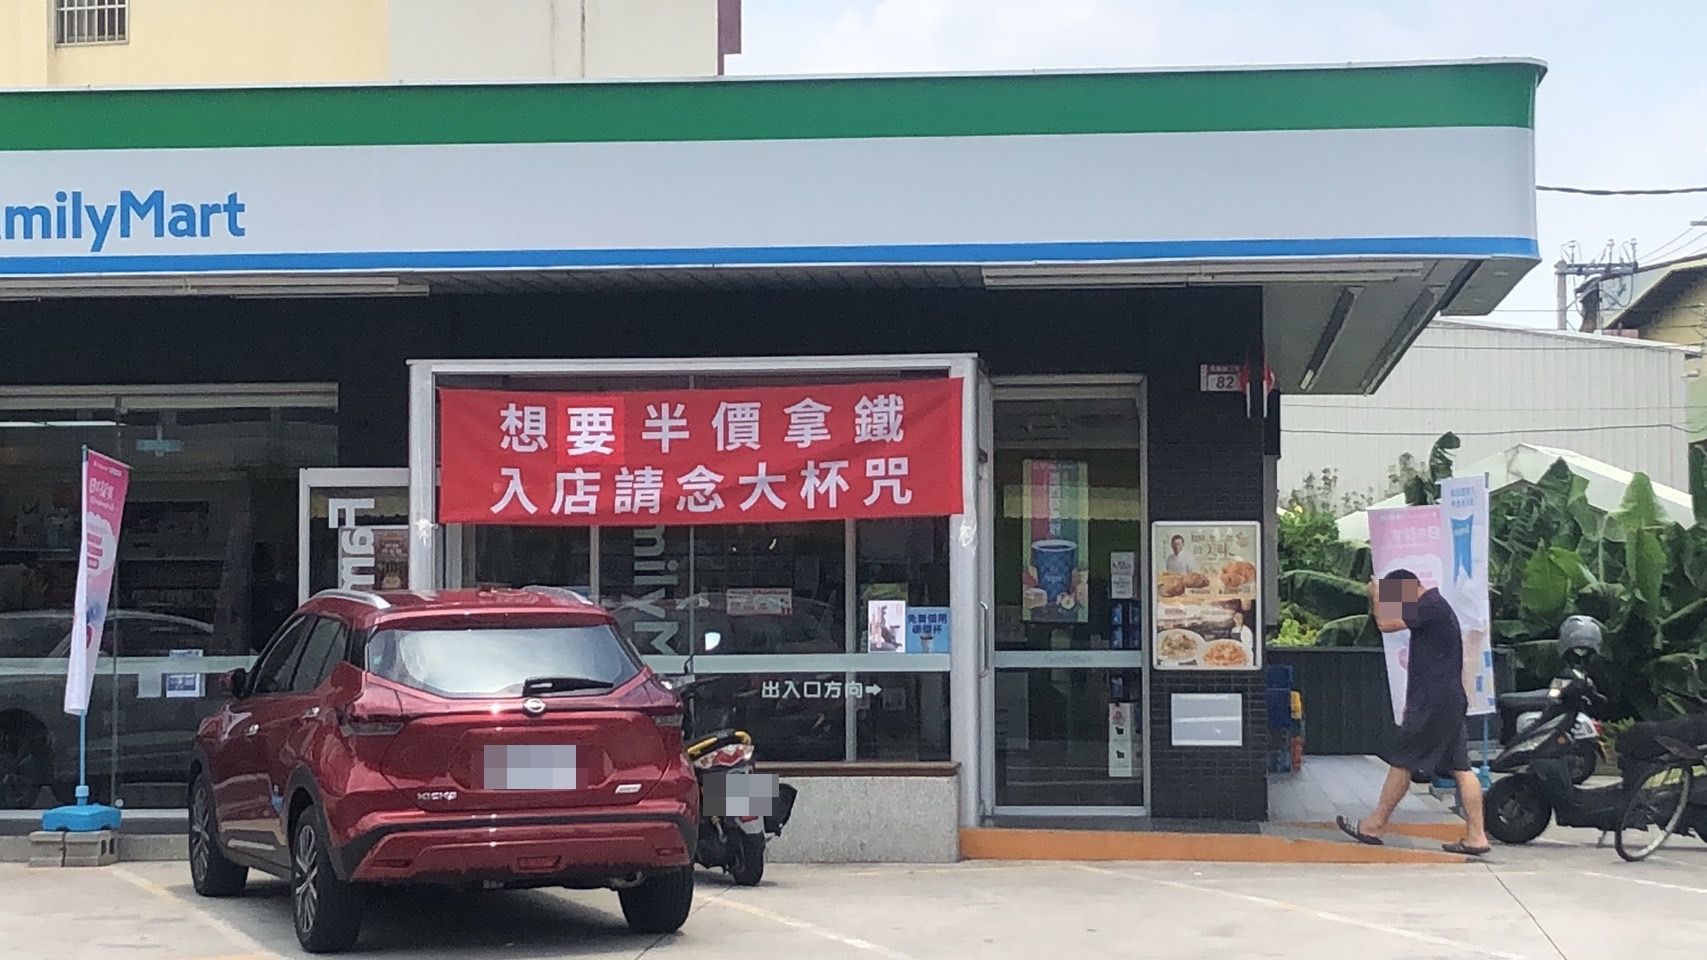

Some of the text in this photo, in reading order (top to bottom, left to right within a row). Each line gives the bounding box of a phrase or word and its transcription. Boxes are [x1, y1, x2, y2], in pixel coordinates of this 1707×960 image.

[0, 190, 245, 252] milyMart
[1216, 376, 1234, 389] 82
[500, 394, 904, 456] 想要半價拿鐵
[490, 457, 912, 515] 入店請念大杯咒
[761, 680, 863, 699] 出入口方向
